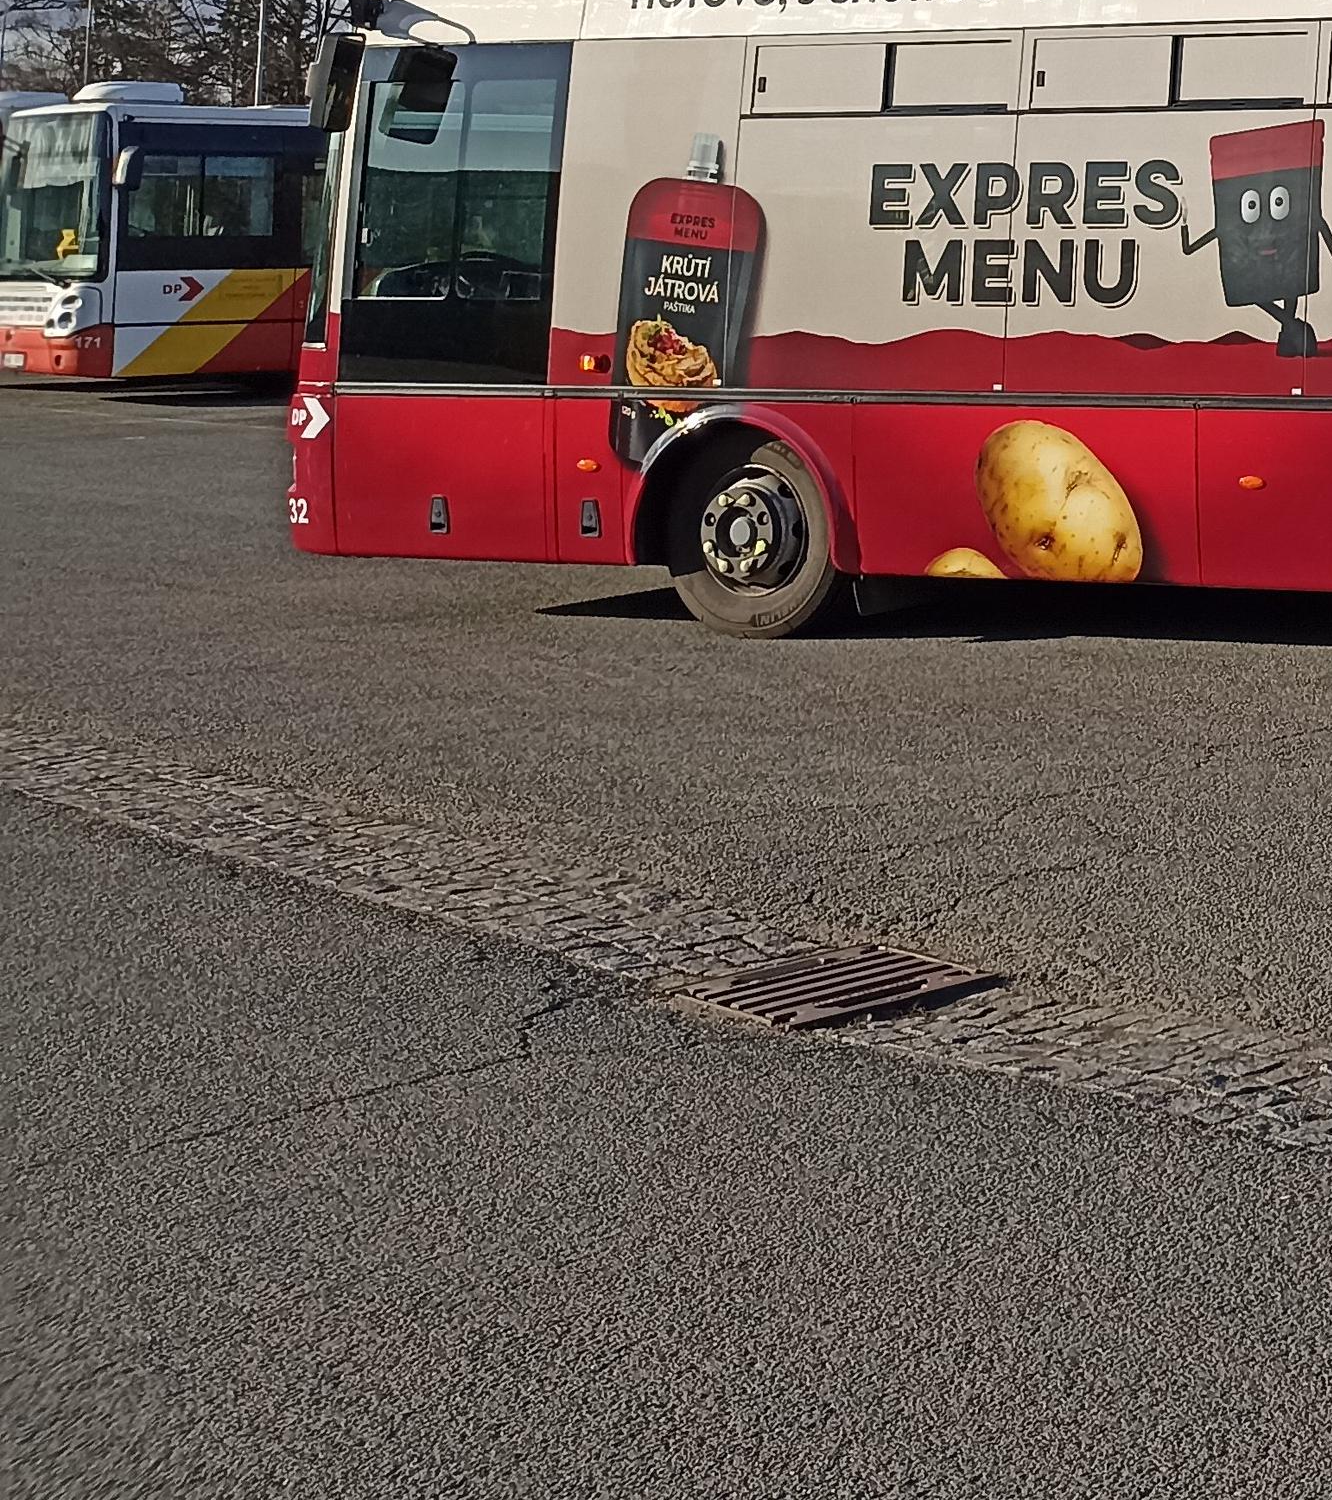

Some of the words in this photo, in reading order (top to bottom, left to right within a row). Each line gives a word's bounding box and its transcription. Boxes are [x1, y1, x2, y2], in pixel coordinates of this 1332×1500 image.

[869, 159, 1183, 229] EXPRES
[670, 213, 716, 229] EXPRES
[674, 227, 708, 240] MENU
[661, 253, 712, 278] KRŮTÍ
[902, 239, 1140, 308] MENU
[162, 283, 182, 295] DP
[644, 274, 719, 303] JÁTROVÁ
[663, 301, 696, 314] PAŠTIKA
[291, 408, 307, 426] DP
[288, 498, 309, 524] 32
